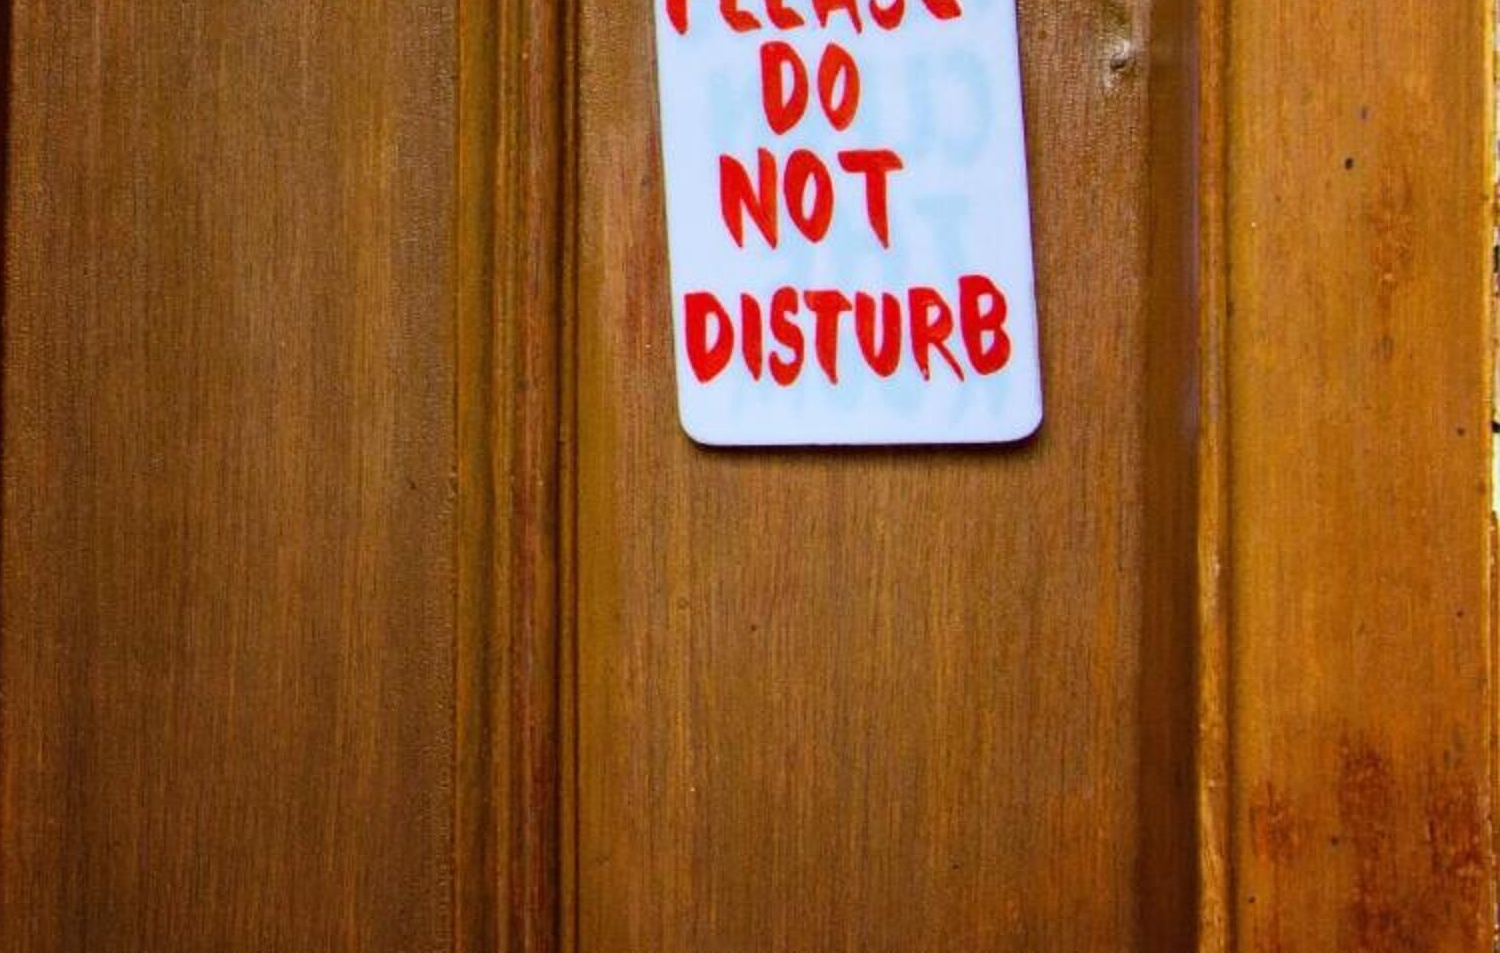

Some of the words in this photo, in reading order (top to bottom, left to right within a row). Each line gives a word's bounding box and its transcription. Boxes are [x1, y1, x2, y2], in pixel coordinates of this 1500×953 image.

[760, 41, 860, 135] DO
[719, 148, 903, 248] NOT
[684, 274, 1011, 386] DISTURB
